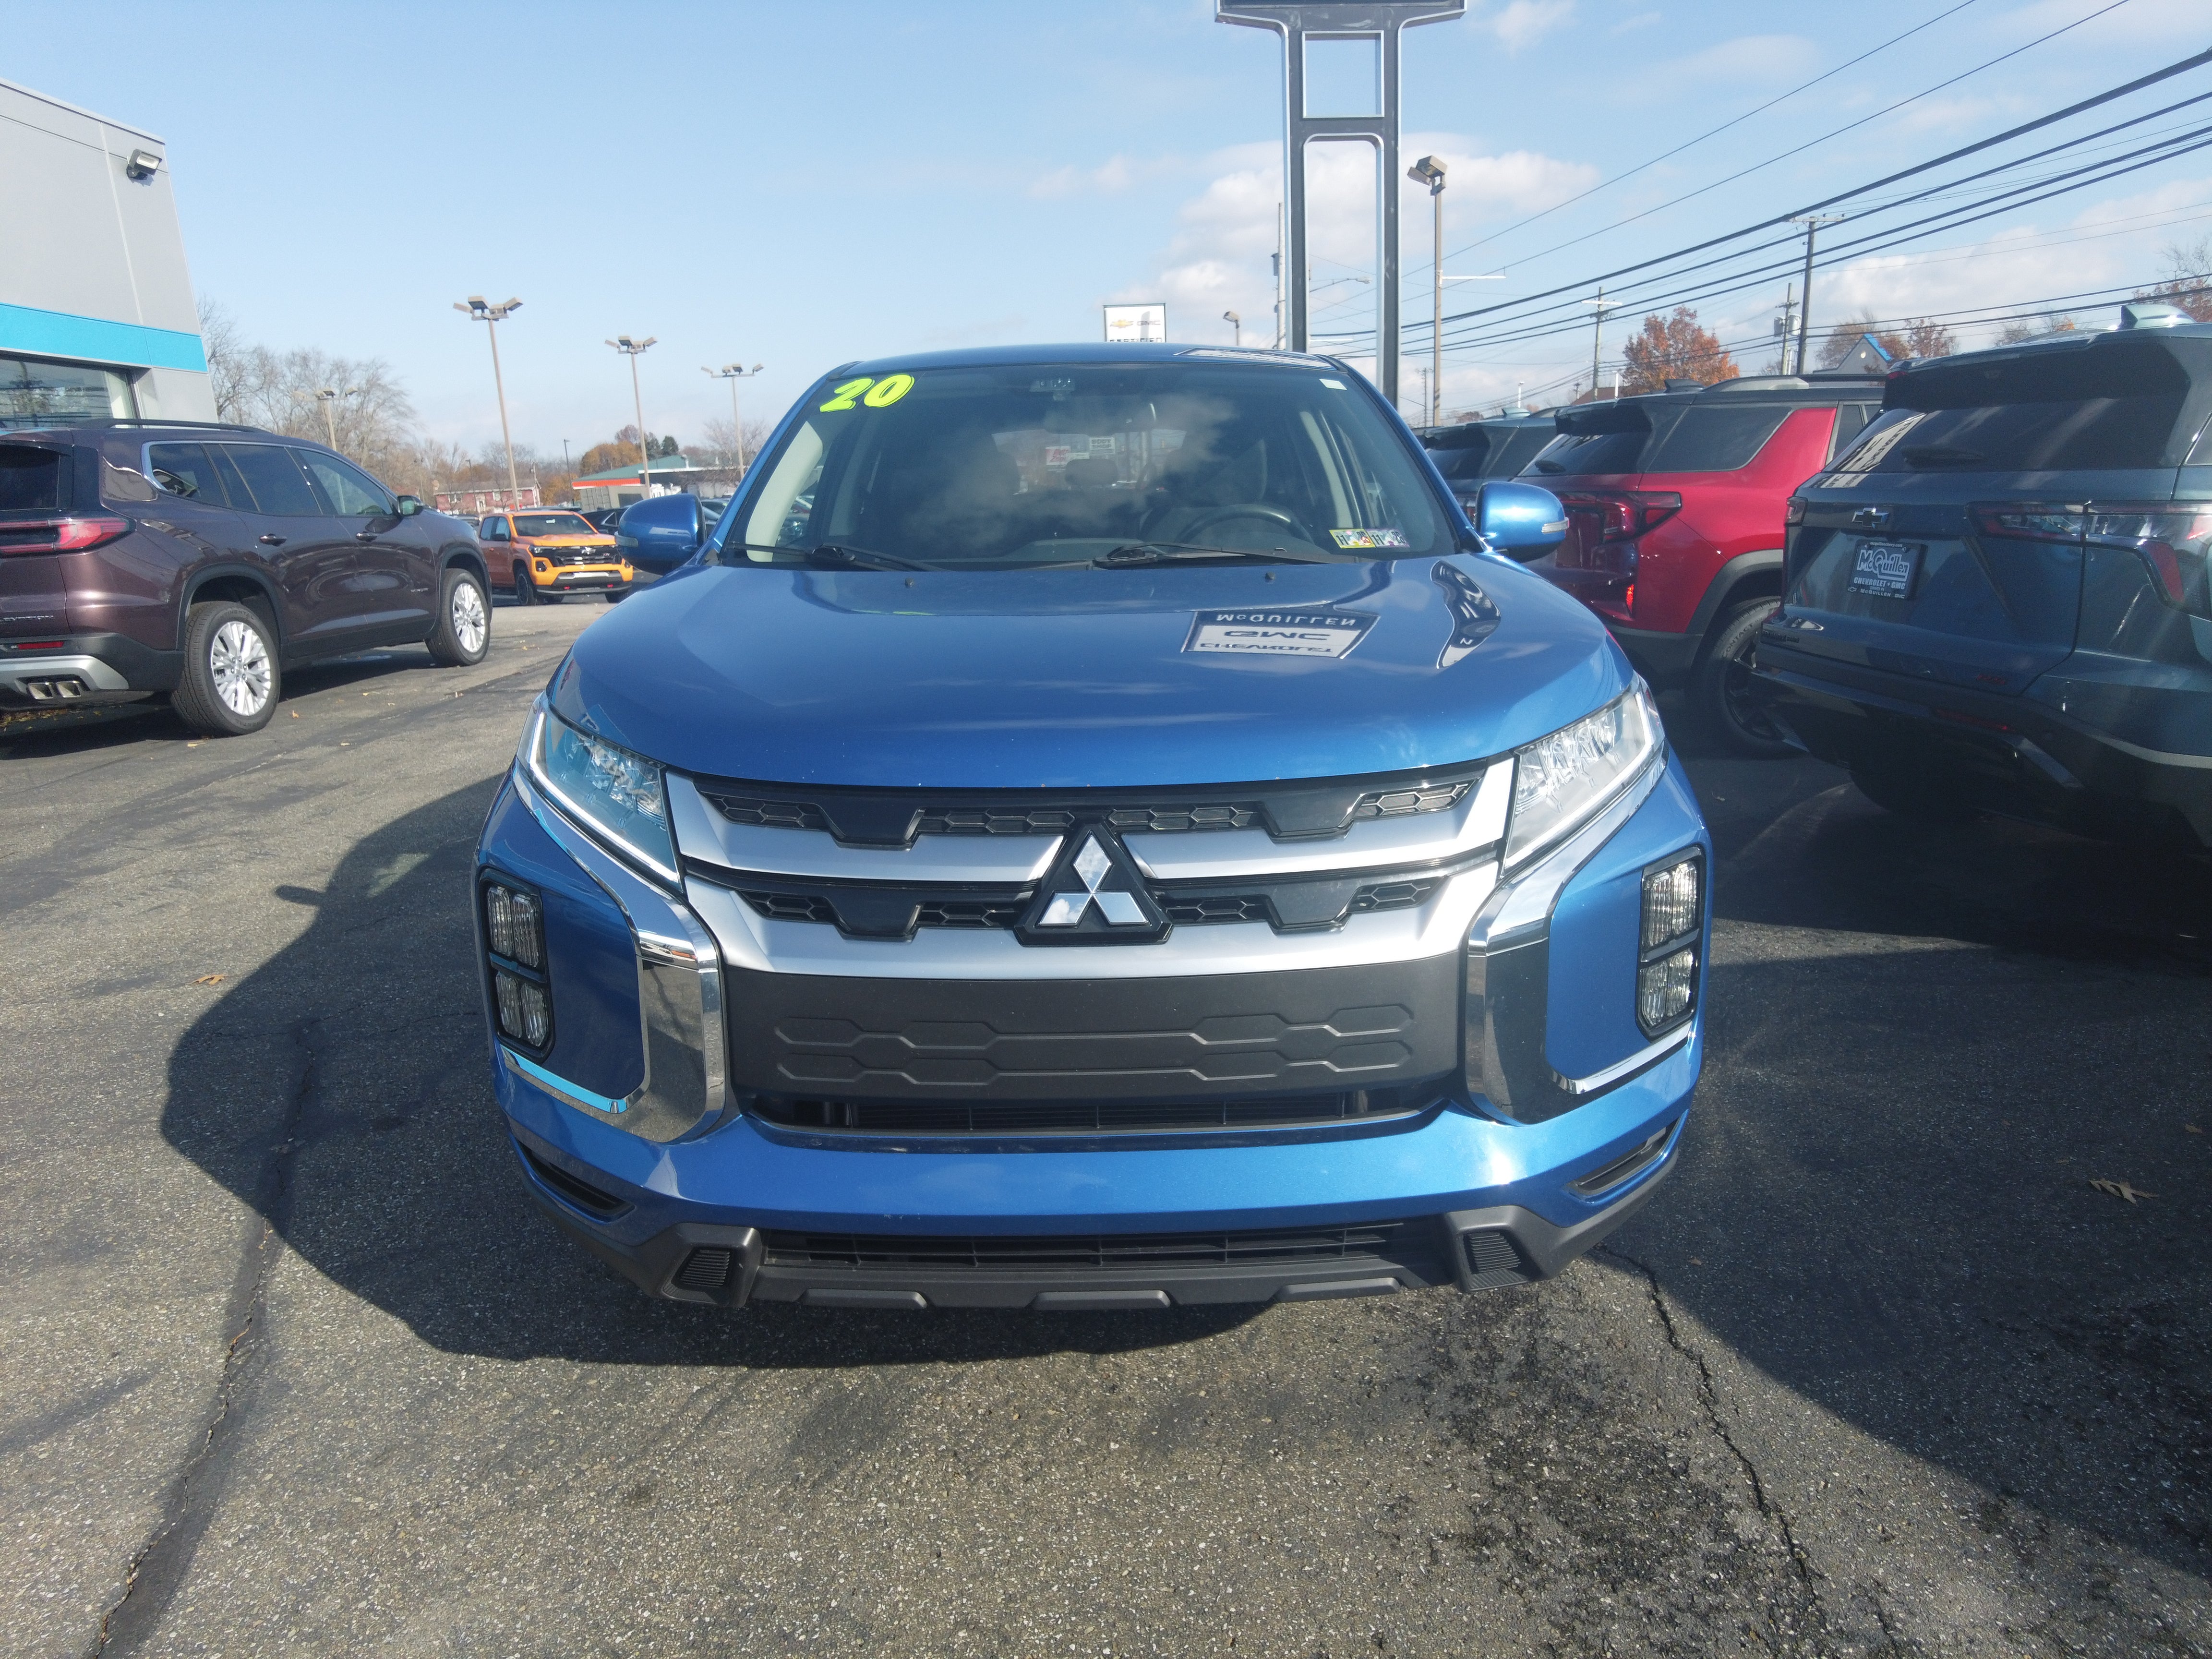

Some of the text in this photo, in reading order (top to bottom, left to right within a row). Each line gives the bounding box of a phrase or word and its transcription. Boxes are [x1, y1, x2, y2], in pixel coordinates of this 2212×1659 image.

[819, 374, 915, 412] 20
[1336, 534, 1348, 545] 11
[1371, 534, 1384, 545] 11
[1857, 548, 1910, 582] McQuillen
[1854, 577, 1887, 587] CHEVROLET
[1891, 581, 1906, 589] GMC
